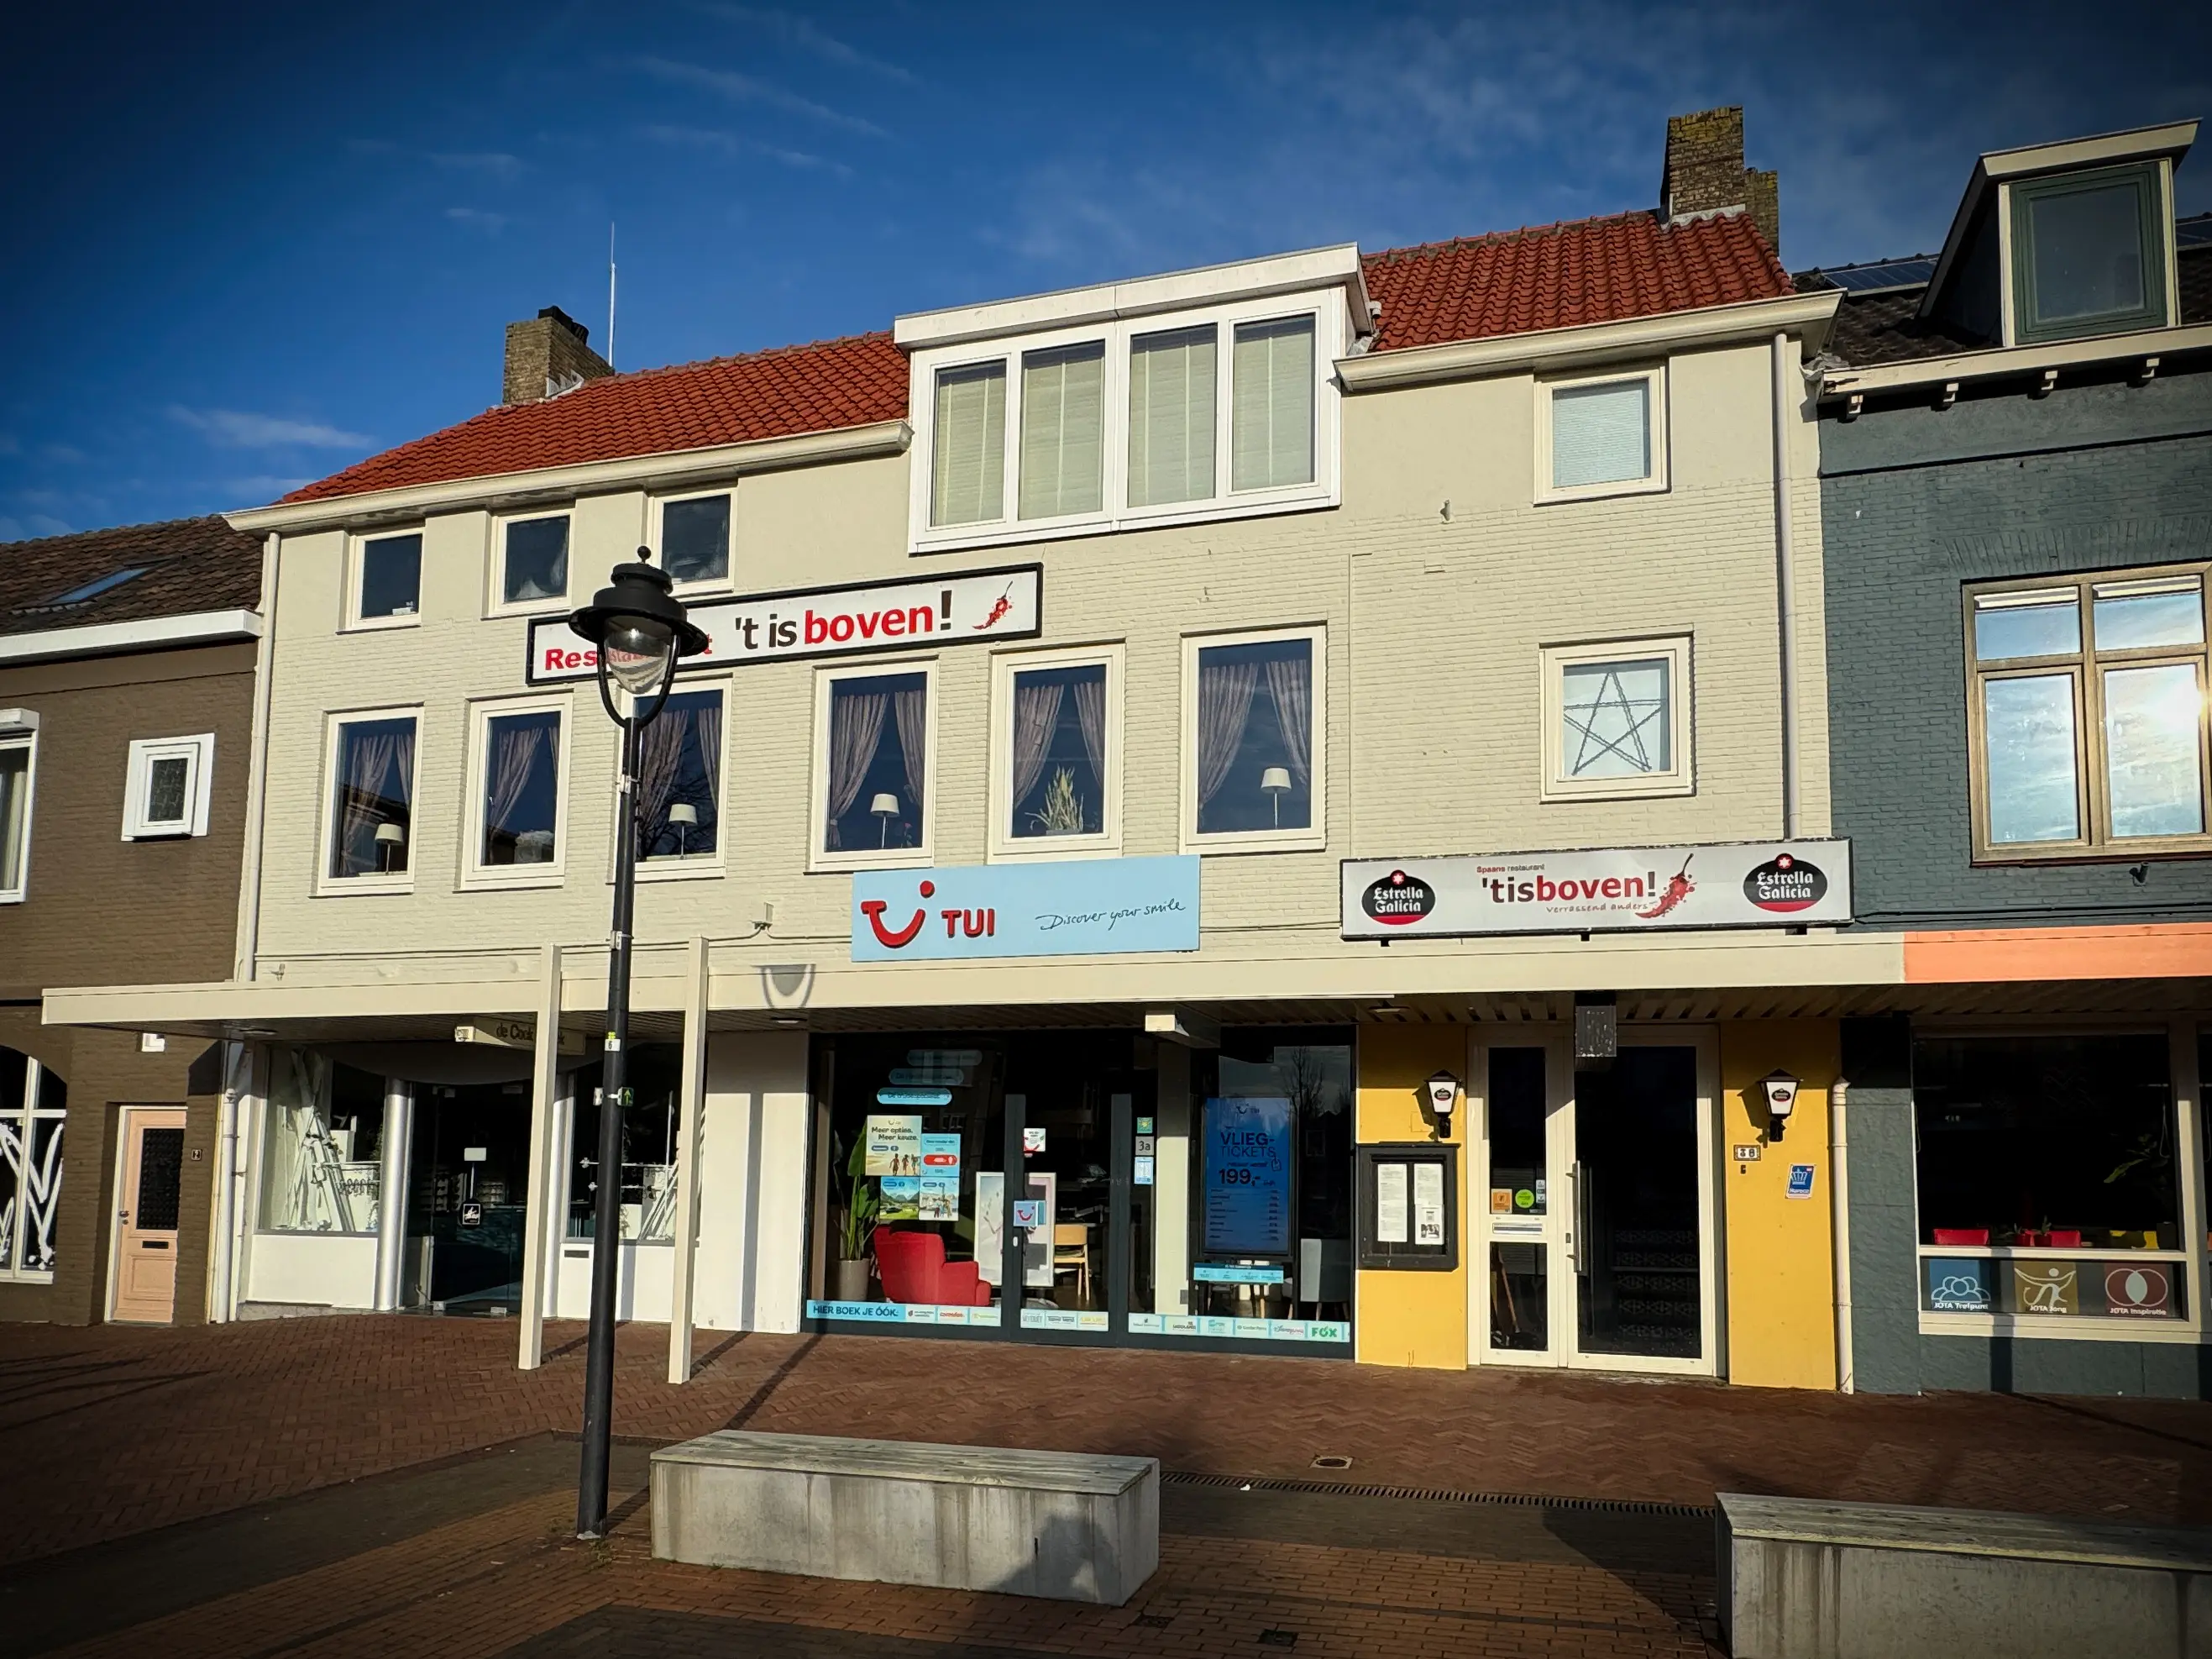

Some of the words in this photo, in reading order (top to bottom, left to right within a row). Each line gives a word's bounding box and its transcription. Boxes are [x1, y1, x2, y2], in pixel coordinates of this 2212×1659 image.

[804, 590, 952, 644] boven!
[1476, 865, 1506, 874] Spaans
[1507, 864, 1545, 872] restaurant
[1757, 871, 1814, 885] Estrella
[1373, 887, 1424, 900] Estrella
[1759, 885, 1812, 900] Galicia
[1376, 900, 1422, 914] Galicia
[1546, 903, 1607, 914] verrassend
[1611, 902, 1648, 911] anders
[941, 908, 995, 938] TUI
[1035, 912, 1107, 931] Discover
[1108, 909, 1142, 931] your
[1143, 898, 1186, 916] smile
[1220, 1132, 1276, 1146] VLIEG-
[1138, 1141, 1151, 1152] 3a
[1220, 1146, 1276, 1158] TICKETS
[813, 1305, 834, 1315] HIER
[836, 1306, 861, 1315] BOEK
[862, 1307, 874, 1316] JE
[1312, 1326, 1338, 1338] FOX
